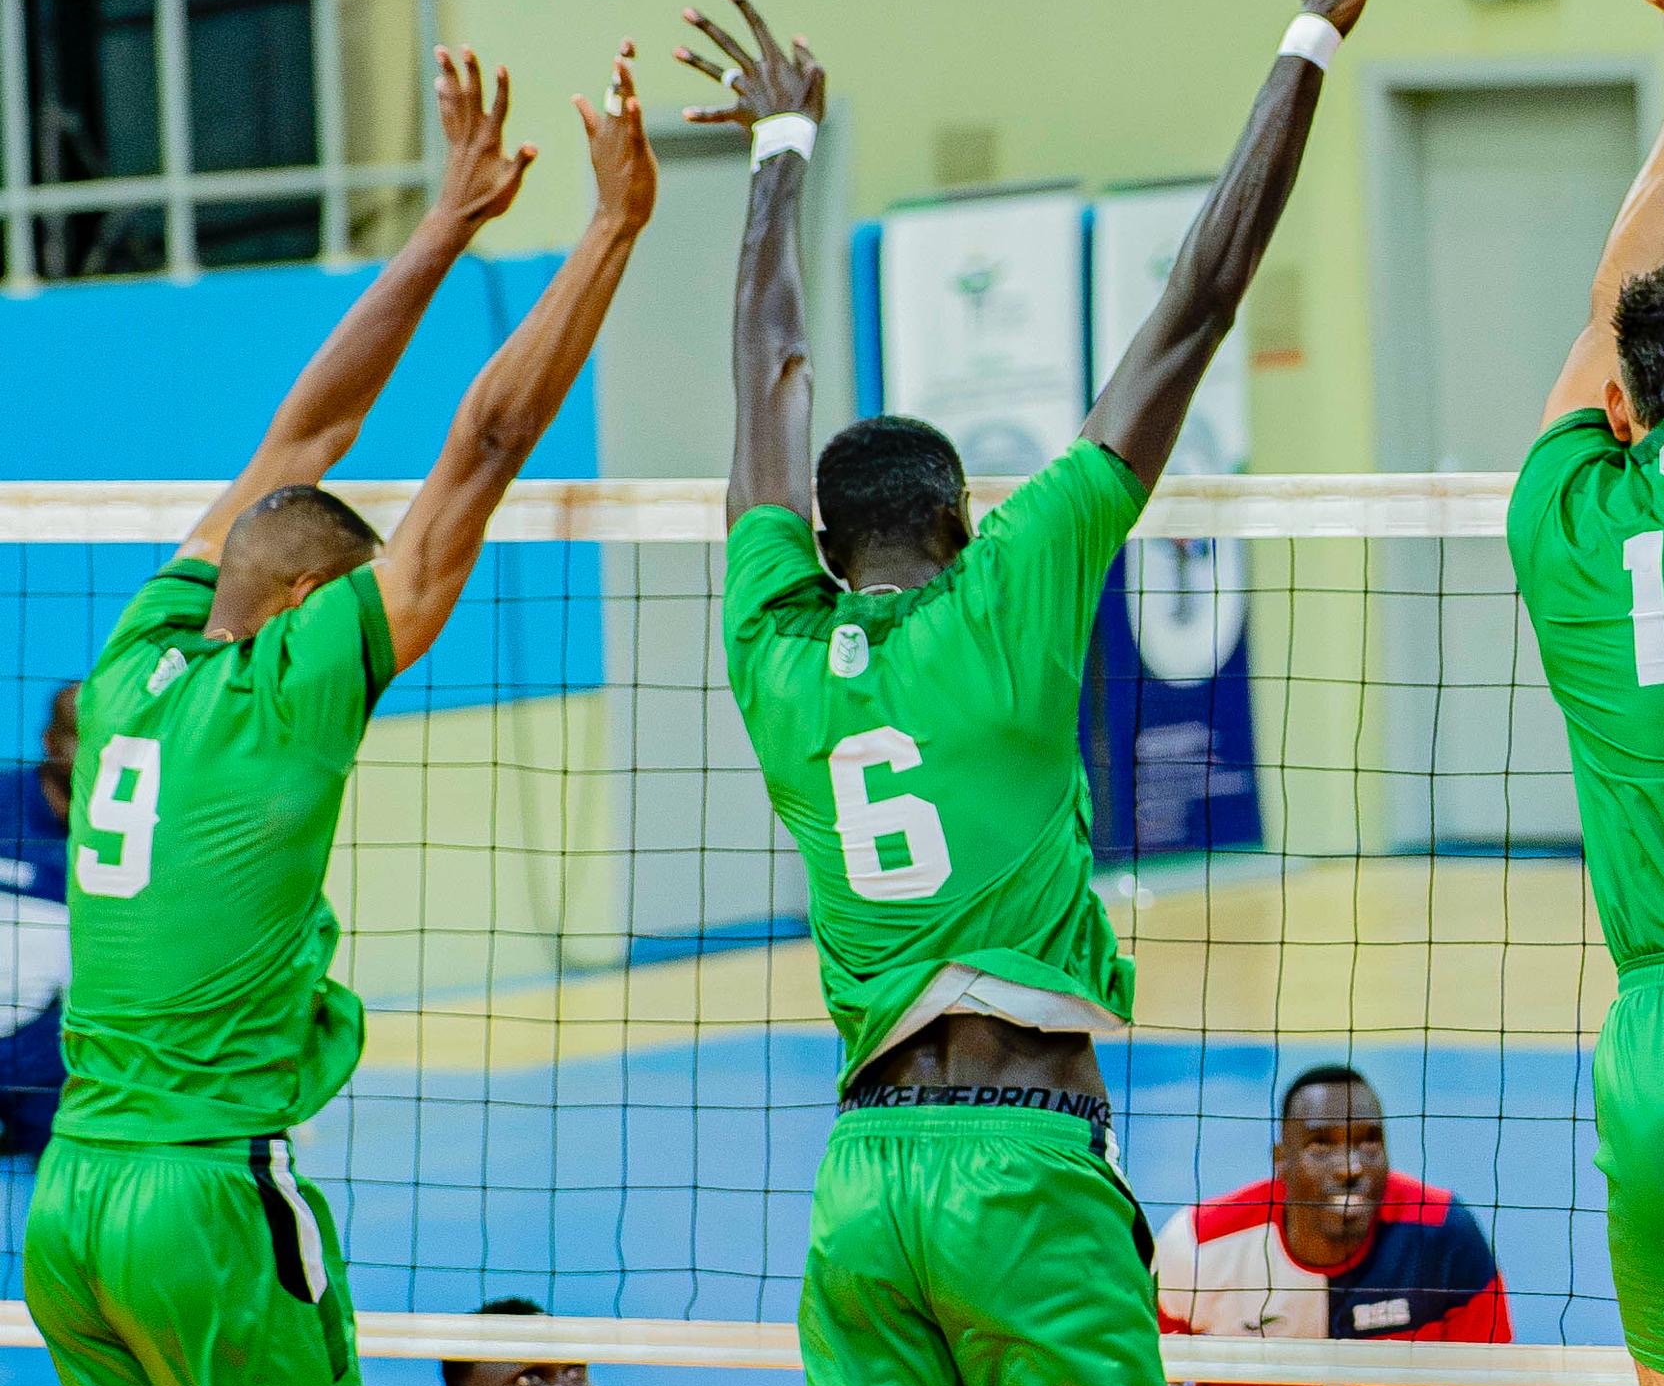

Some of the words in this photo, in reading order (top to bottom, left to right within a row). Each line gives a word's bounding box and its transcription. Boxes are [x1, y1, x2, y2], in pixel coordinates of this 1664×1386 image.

[74, 734, 162, 899] 9
[829, 725, 953, 902] 6
[974, 1085, 1051, 1110] PRO
